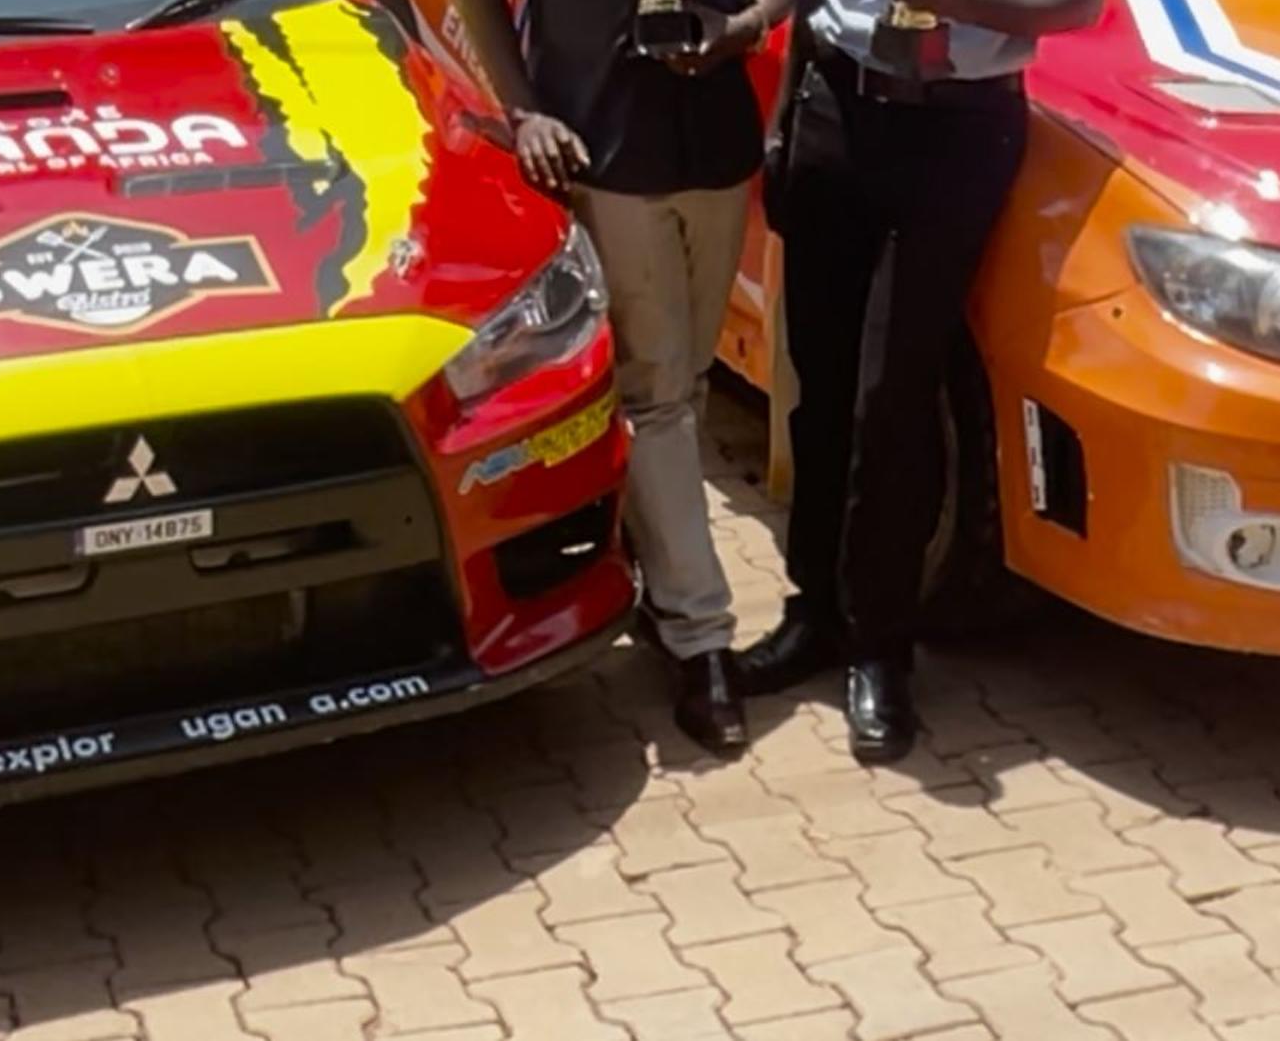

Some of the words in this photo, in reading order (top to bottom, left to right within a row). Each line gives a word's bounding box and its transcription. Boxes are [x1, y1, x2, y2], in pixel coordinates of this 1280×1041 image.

[45, 154, 83, 171] OF
[102, 150, 215, 171] AFRICA
[308, 672, 430, 714] a.com
